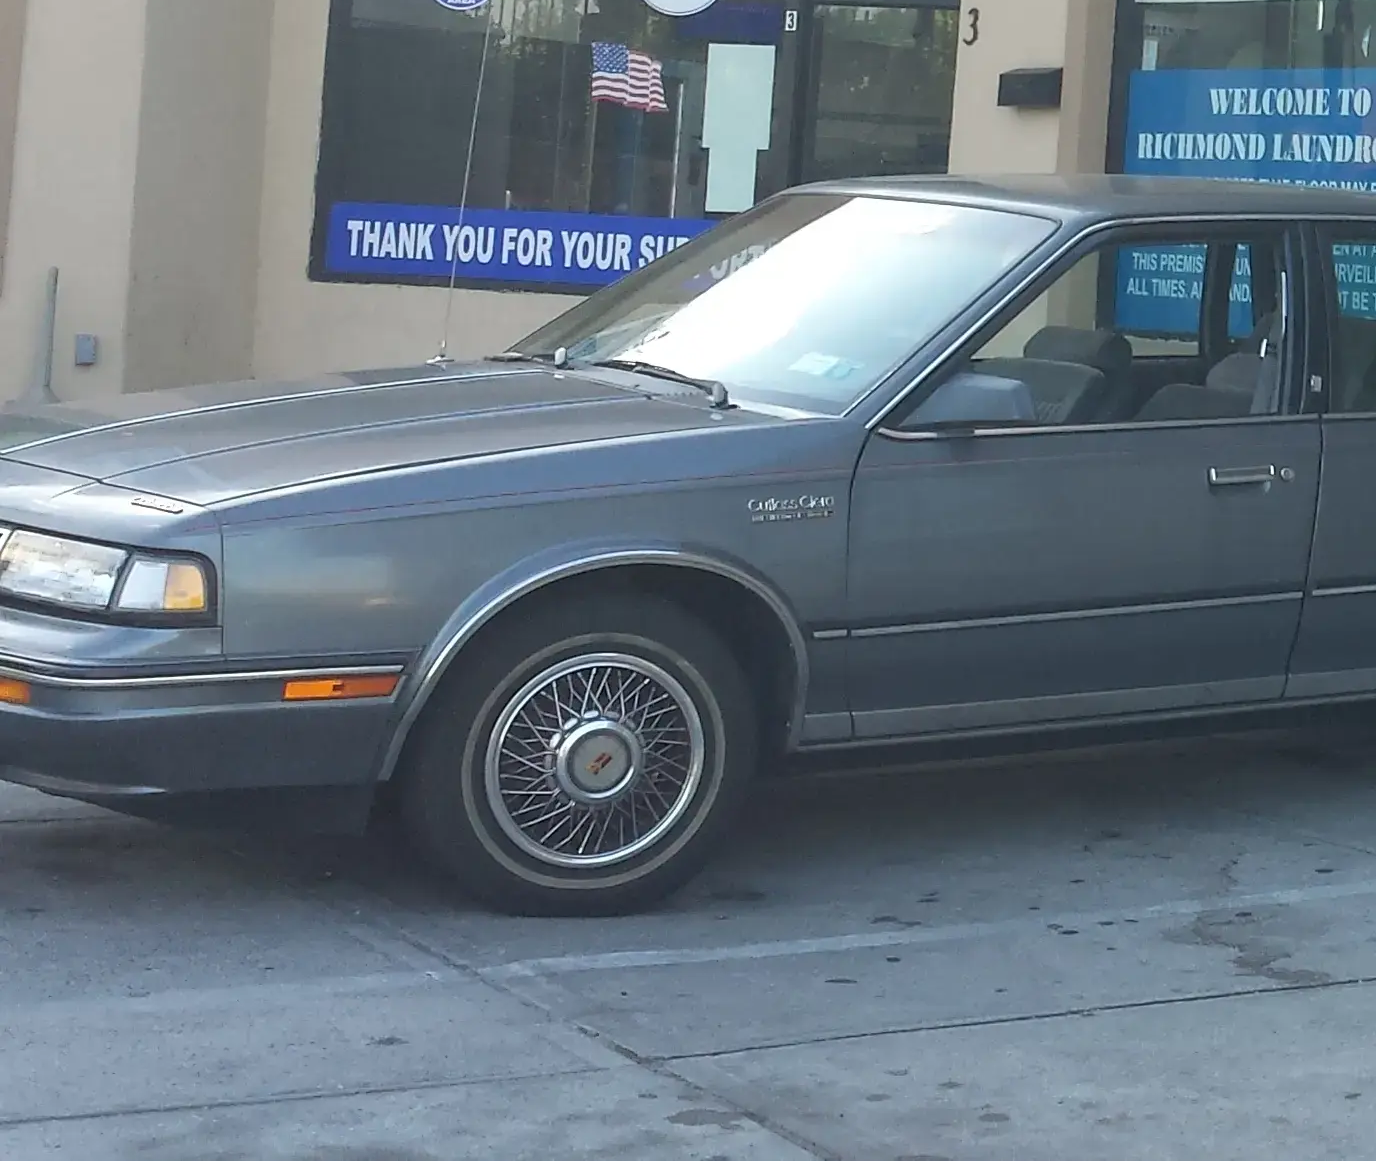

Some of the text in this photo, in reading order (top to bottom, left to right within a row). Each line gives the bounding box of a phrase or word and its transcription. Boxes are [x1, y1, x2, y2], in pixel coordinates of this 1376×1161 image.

[962, 7, 979, 46] 3
[1209, 87, 1372, 117] WELCOME TO
[1137, 132, 1266, 161] RICHMOND
[347, 219, 434, 261] THANK
[441, 224, 495, 264] YOU
[502, 227, 553, 268] FOR
[560, 230, 632, 271] YOUR
[1132, 252, 1158, 271] THIS
[1126, 277, 1149, 296] ALL
[1352, 291, 1370, 311] BE
